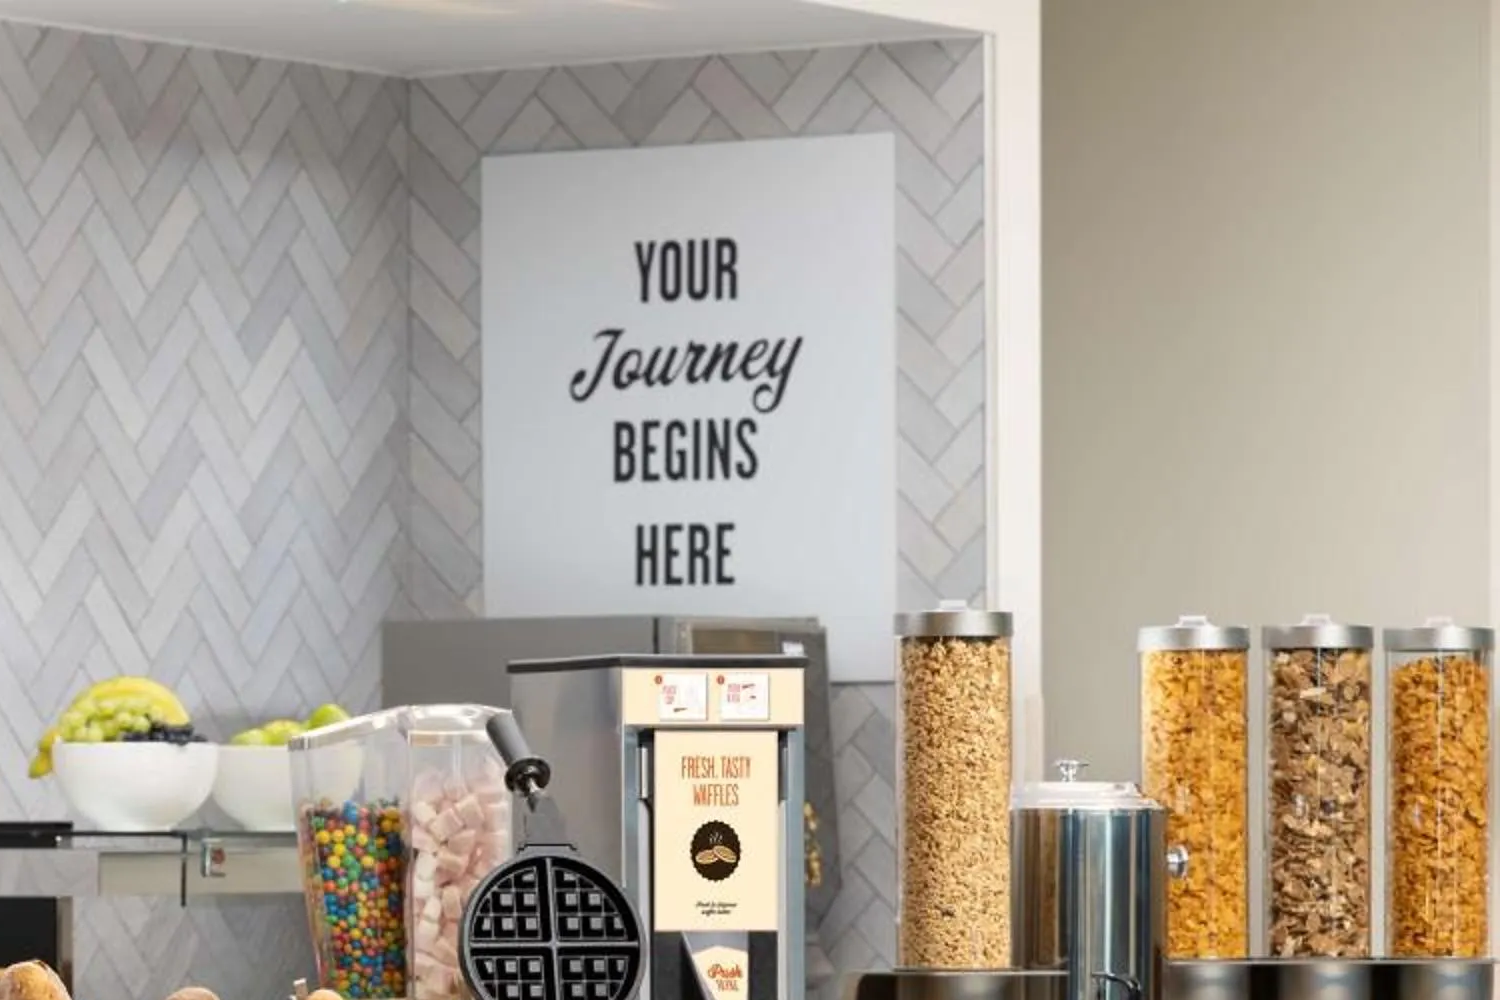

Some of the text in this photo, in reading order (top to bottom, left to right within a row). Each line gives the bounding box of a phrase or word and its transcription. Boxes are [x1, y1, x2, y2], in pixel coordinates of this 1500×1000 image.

[634, 237, 738, 303] YOUR
[569, 328, 804, 413] Journey
[613, 418, 759, 483] BEGINS
[635, 523, 736, 586] HERE
[692, 783, 739, 807] WAFFLES
[720, 755, 752, 779] TASTY
